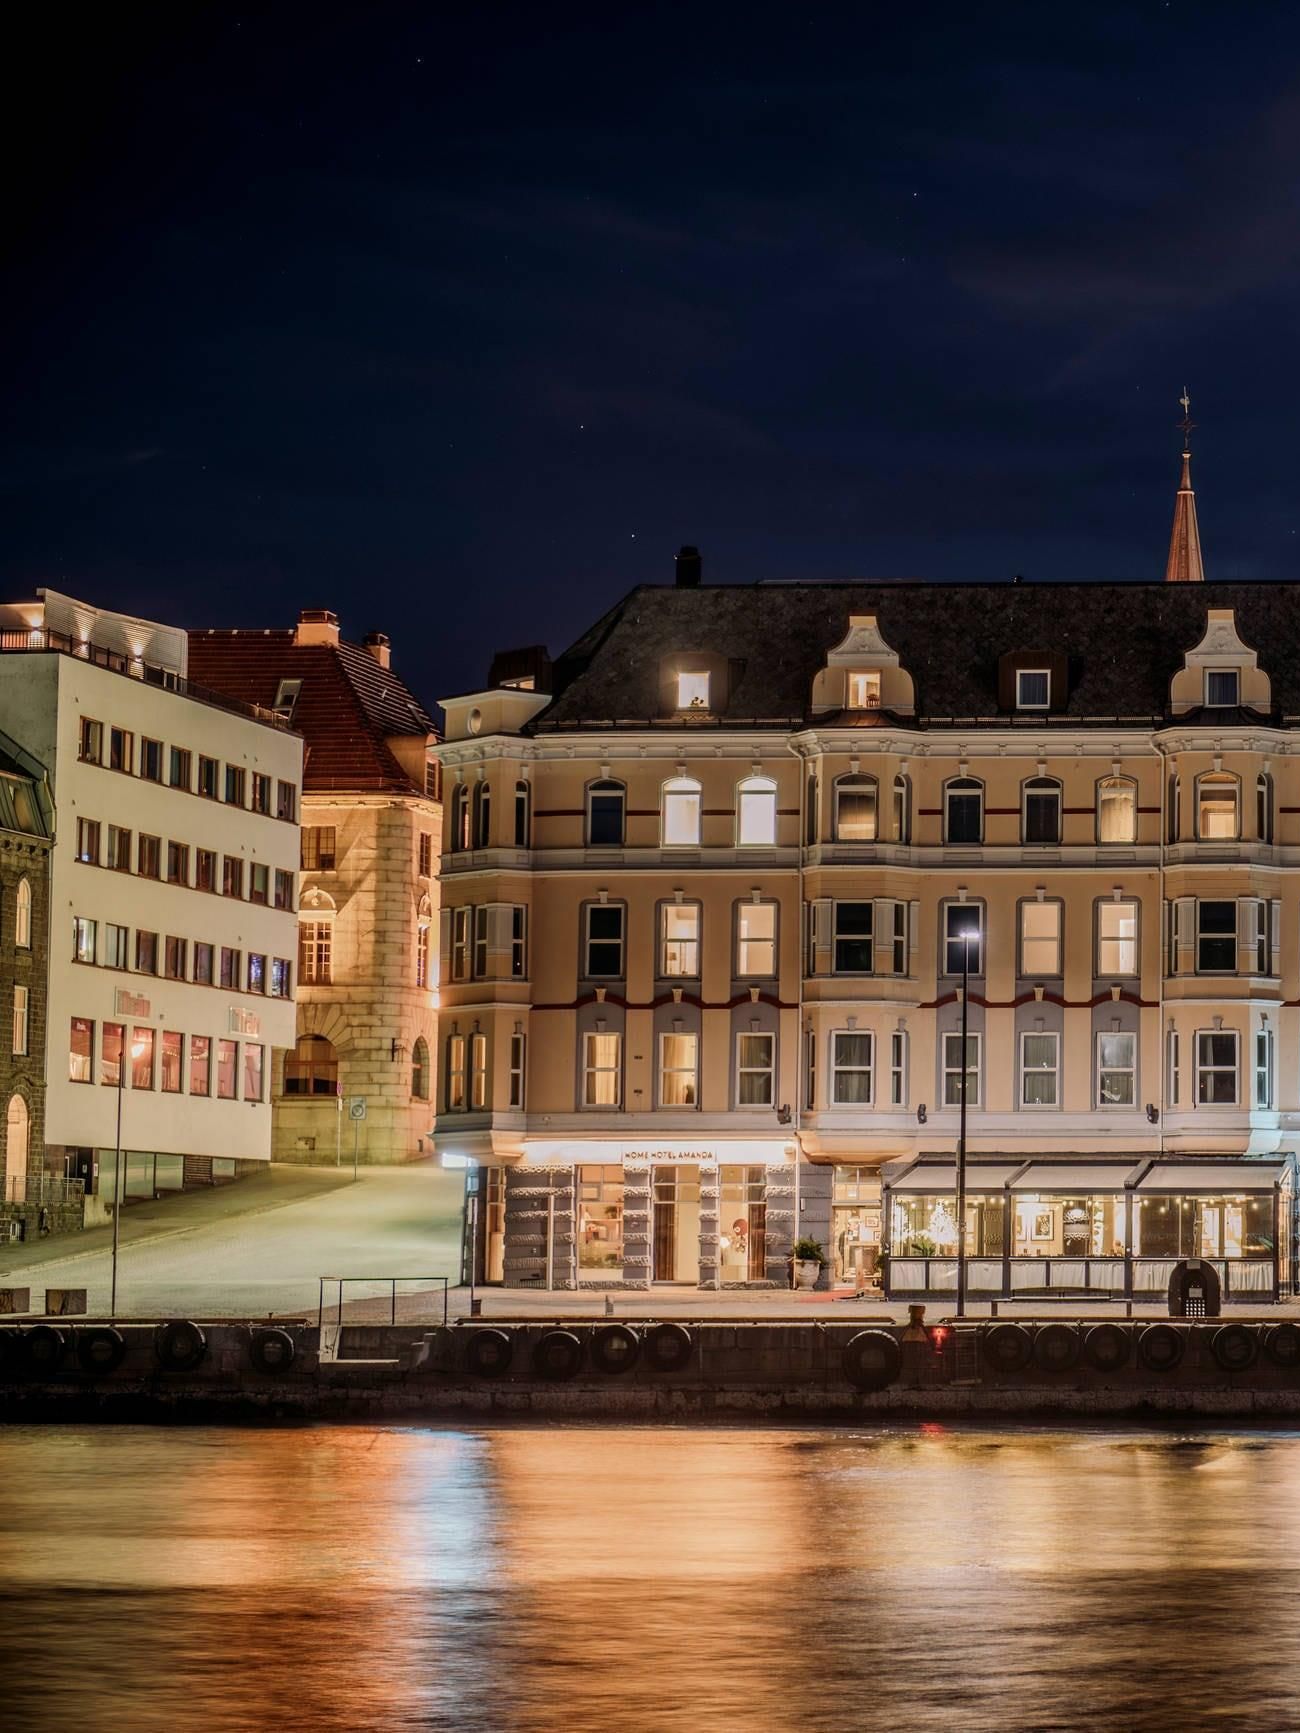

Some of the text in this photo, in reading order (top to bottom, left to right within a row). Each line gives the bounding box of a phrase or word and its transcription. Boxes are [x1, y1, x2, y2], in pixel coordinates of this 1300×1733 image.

[625, 1151, 713, 1159] HOME HOTEL AMANDA
